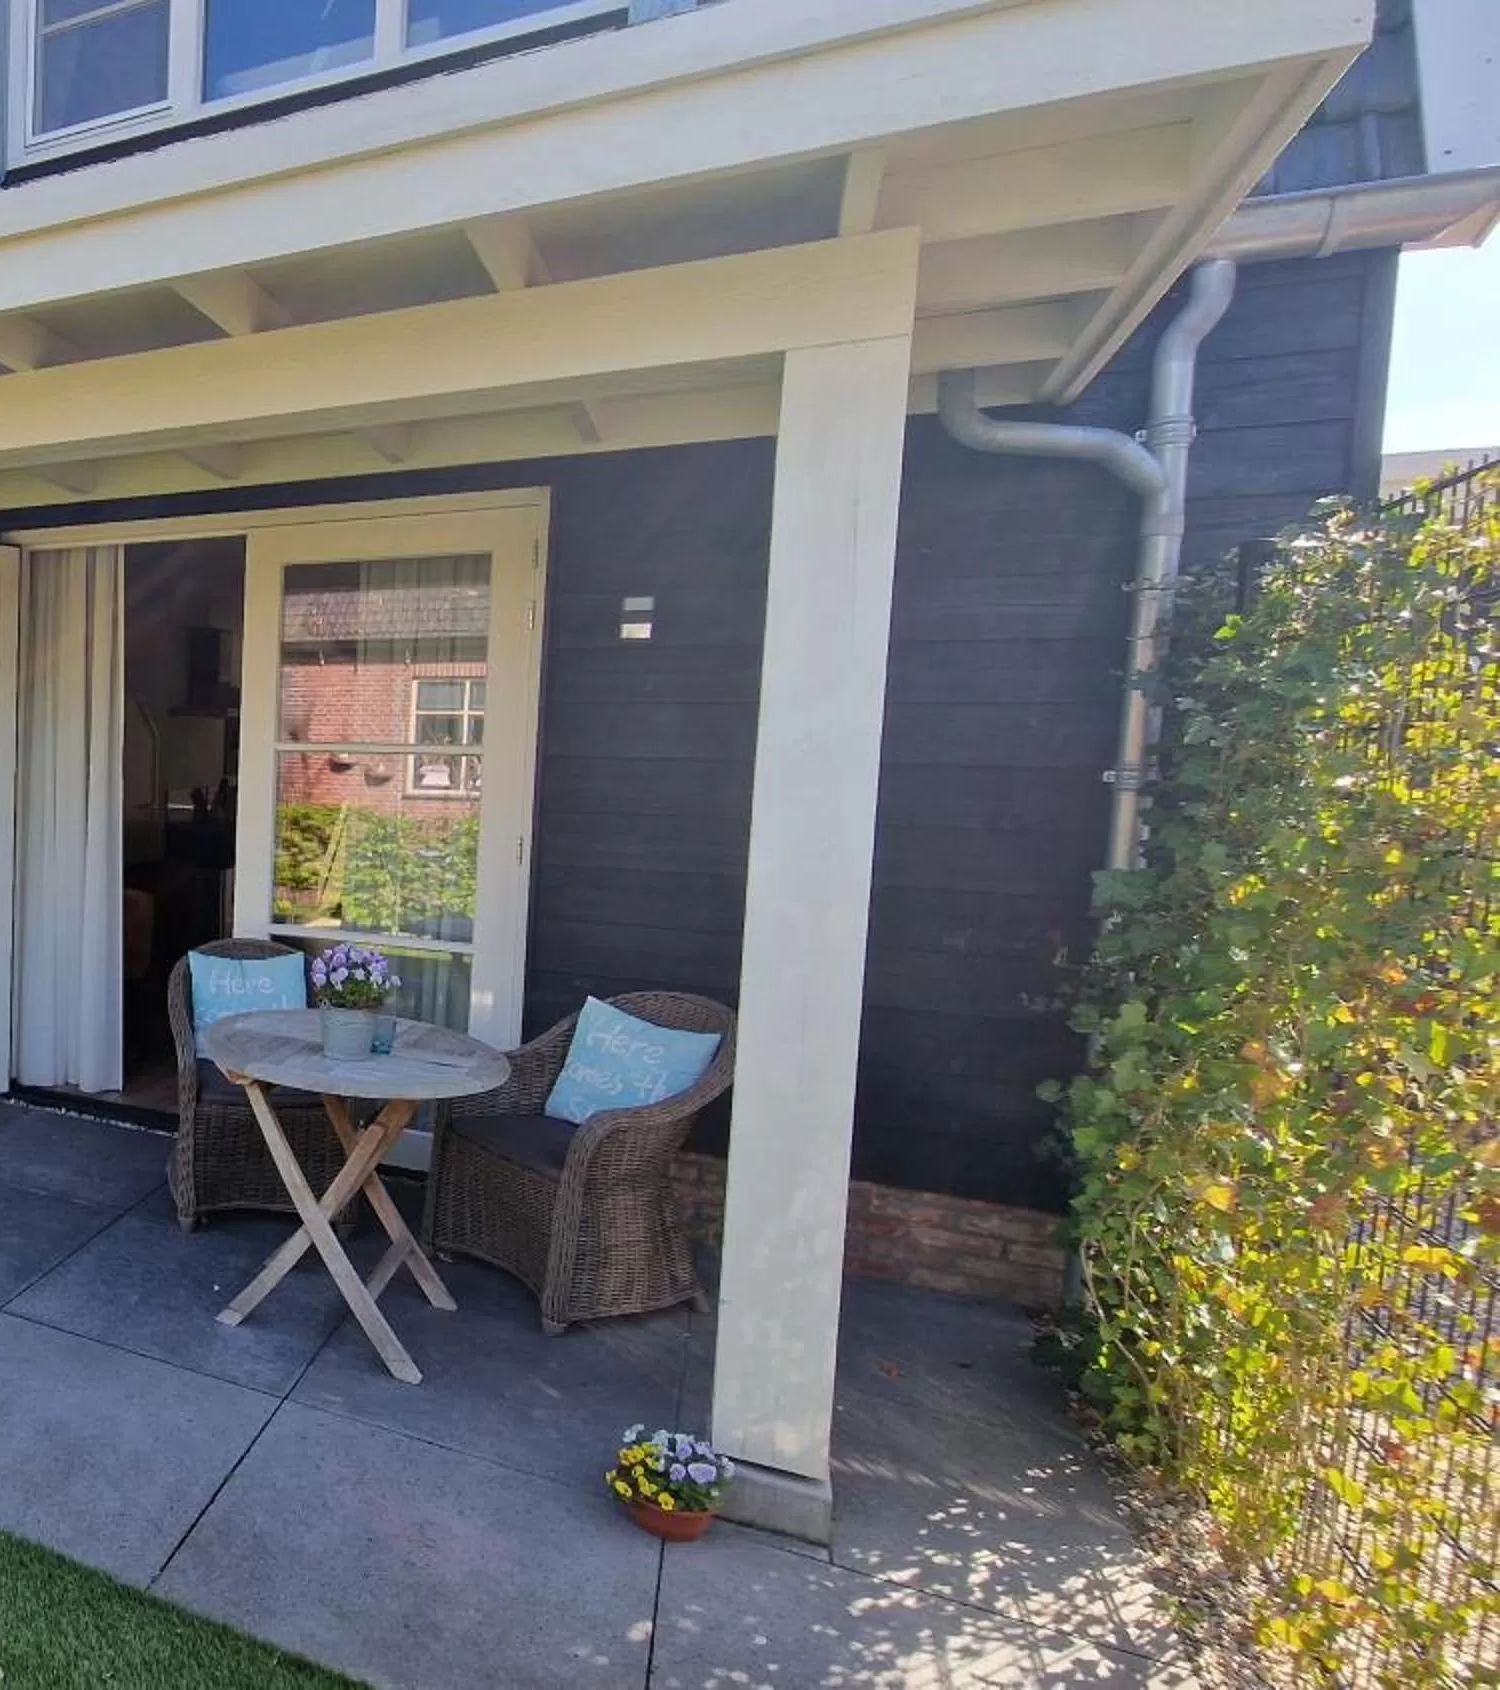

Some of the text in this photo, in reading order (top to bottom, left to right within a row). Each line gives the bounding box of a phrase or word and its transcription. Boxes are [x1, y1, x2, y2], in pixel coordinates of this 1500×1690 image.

[209, 968, 275, 997] Here
[586, 1018, 666, 1065] Here
[564, 1061, 670, 1104] omes th
